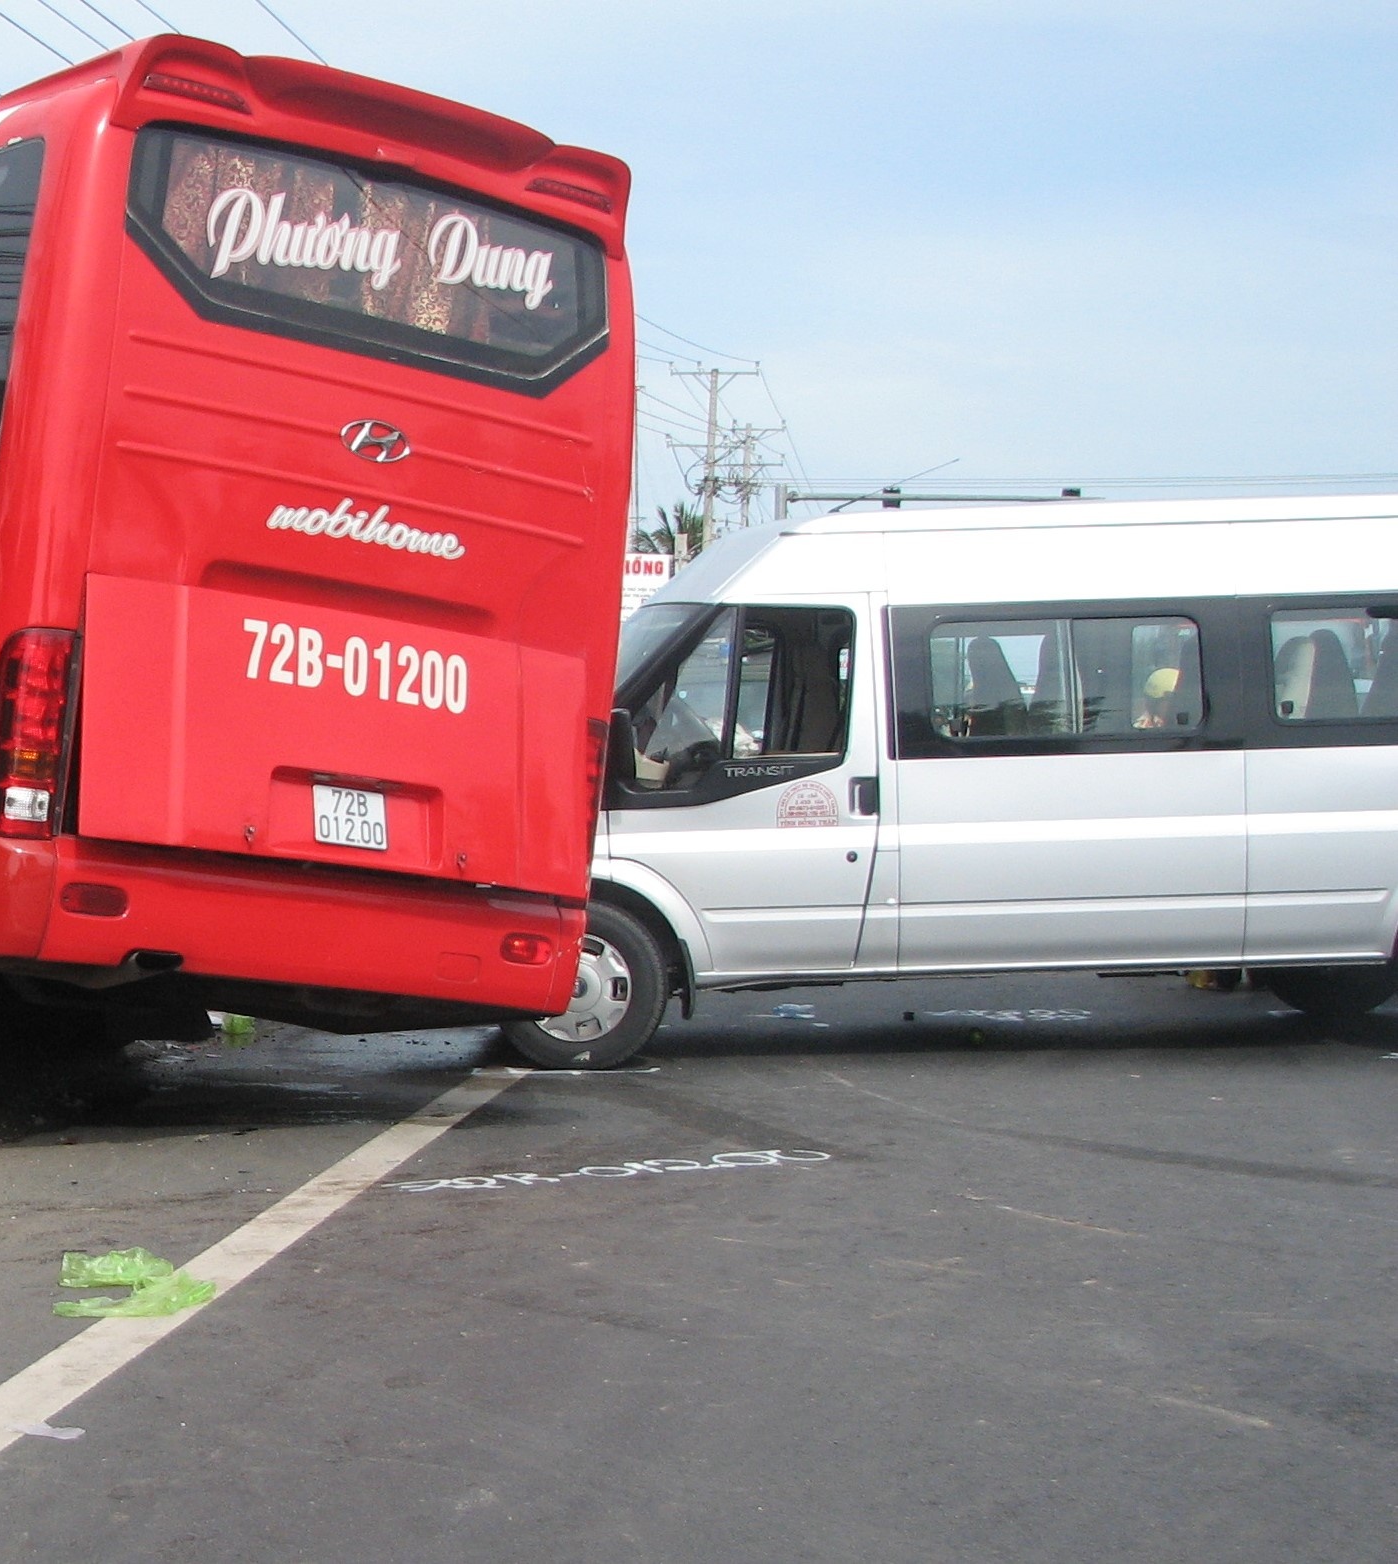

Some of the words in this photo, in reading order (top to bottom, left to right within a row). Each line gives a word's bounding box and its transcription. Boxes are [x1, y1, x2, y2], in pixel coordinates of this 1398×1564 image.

[207, 187, 400, 291] Phương
[427, 209, 554, 311] Dung
[266, 497, 466, 560] mobihome
[243, 618, 468, 714] 72B-01200
[723, 765, 796, 778] TRANSIT
[331, 789, 369, 817] 72B
[319, 815, 384, 846] 012.00
